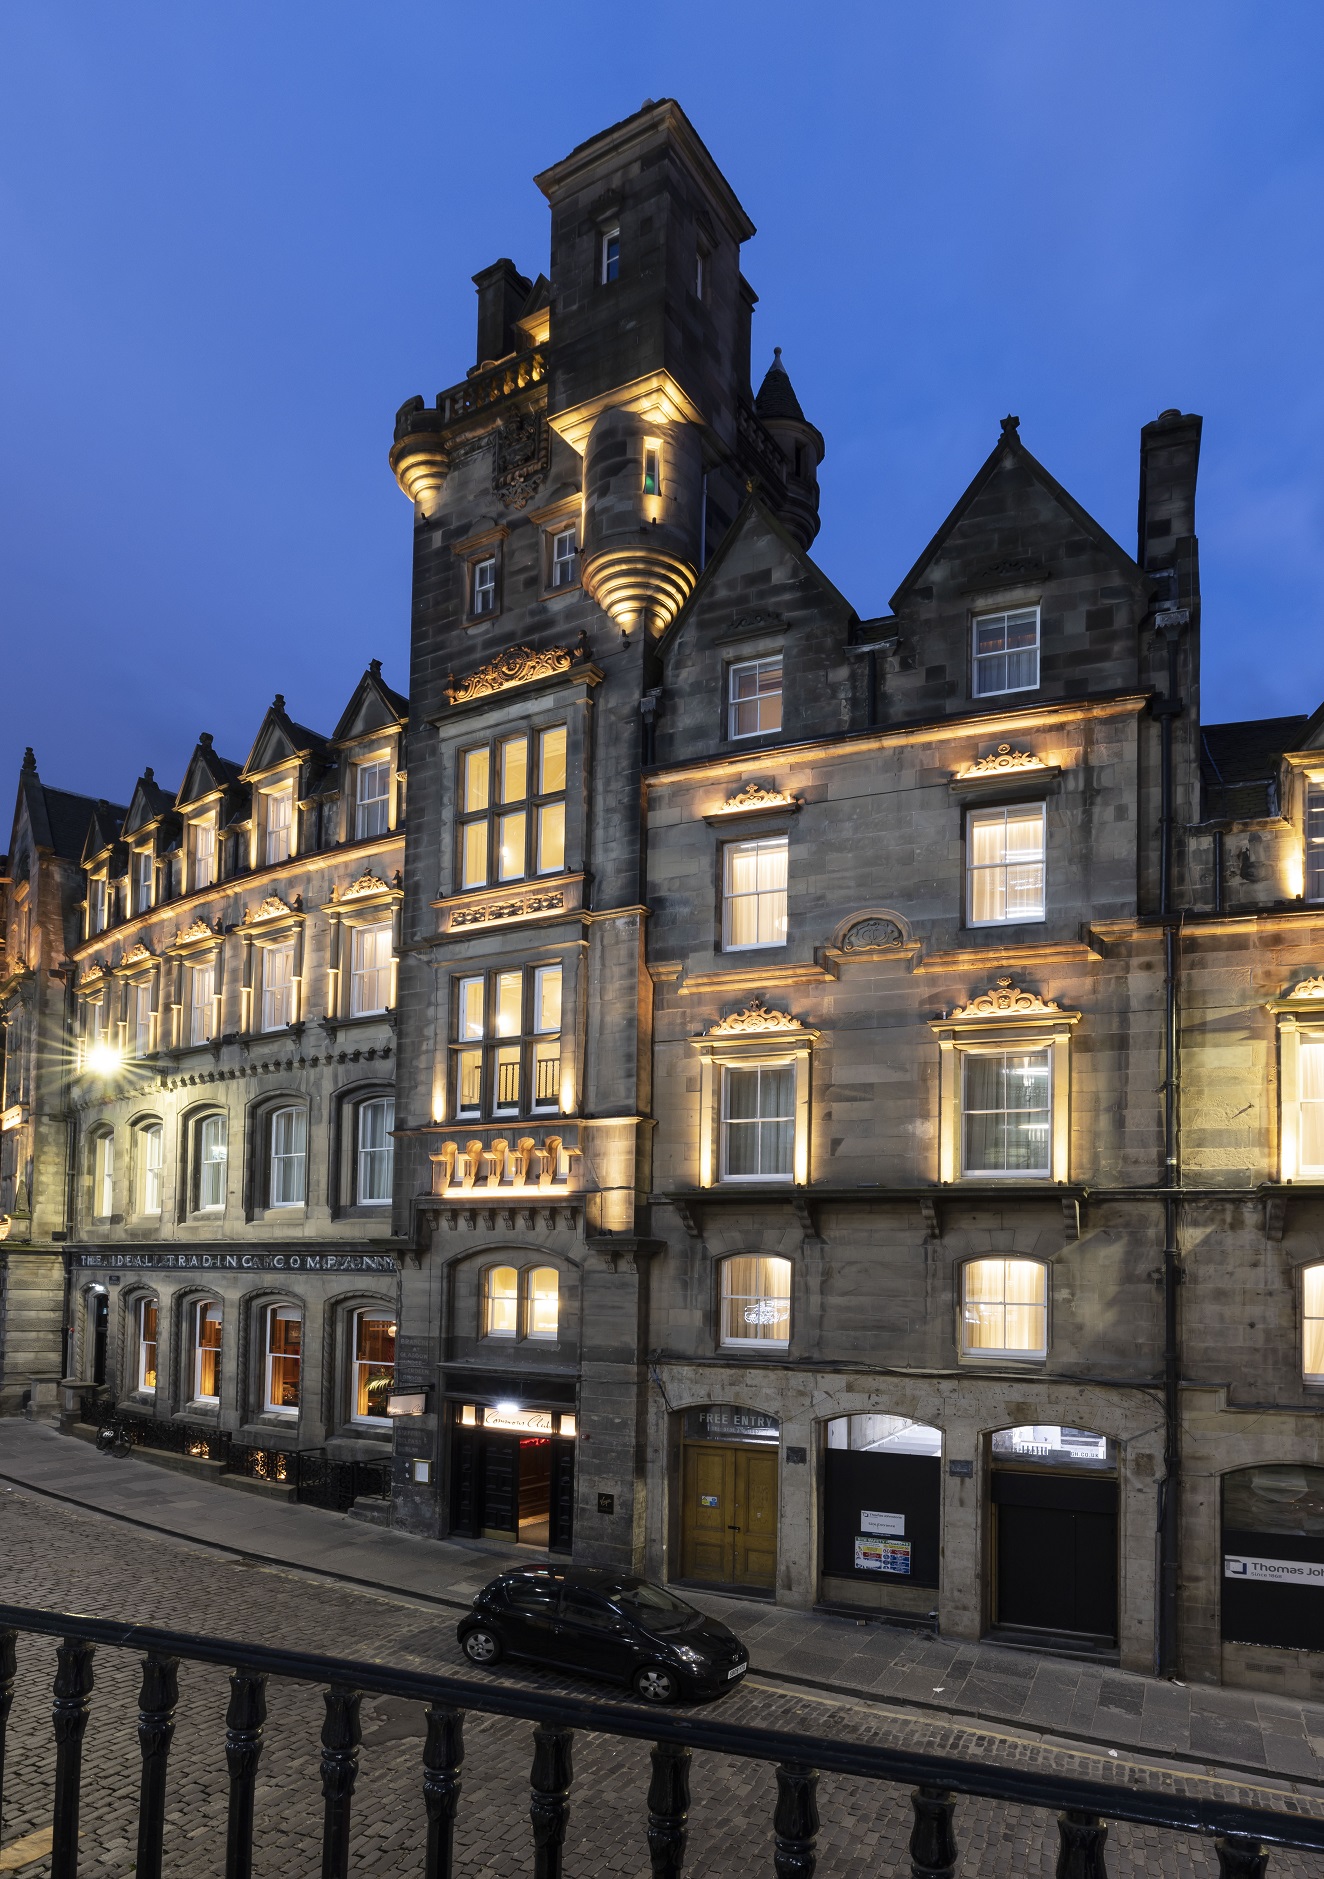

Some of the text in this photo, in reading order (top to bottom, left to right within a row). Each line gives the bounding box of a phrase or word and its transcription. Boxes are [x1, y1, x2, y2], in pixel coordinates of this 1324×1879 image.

[81, 1255, 394, 1270] THE IDEAL TRADING COMPANY
[485, 1411, 551, 1429] Commons Club
[699, 1412, 773, 1427] FREE ENTRY
[1251, 1562, 1304, 1575] Thomas
